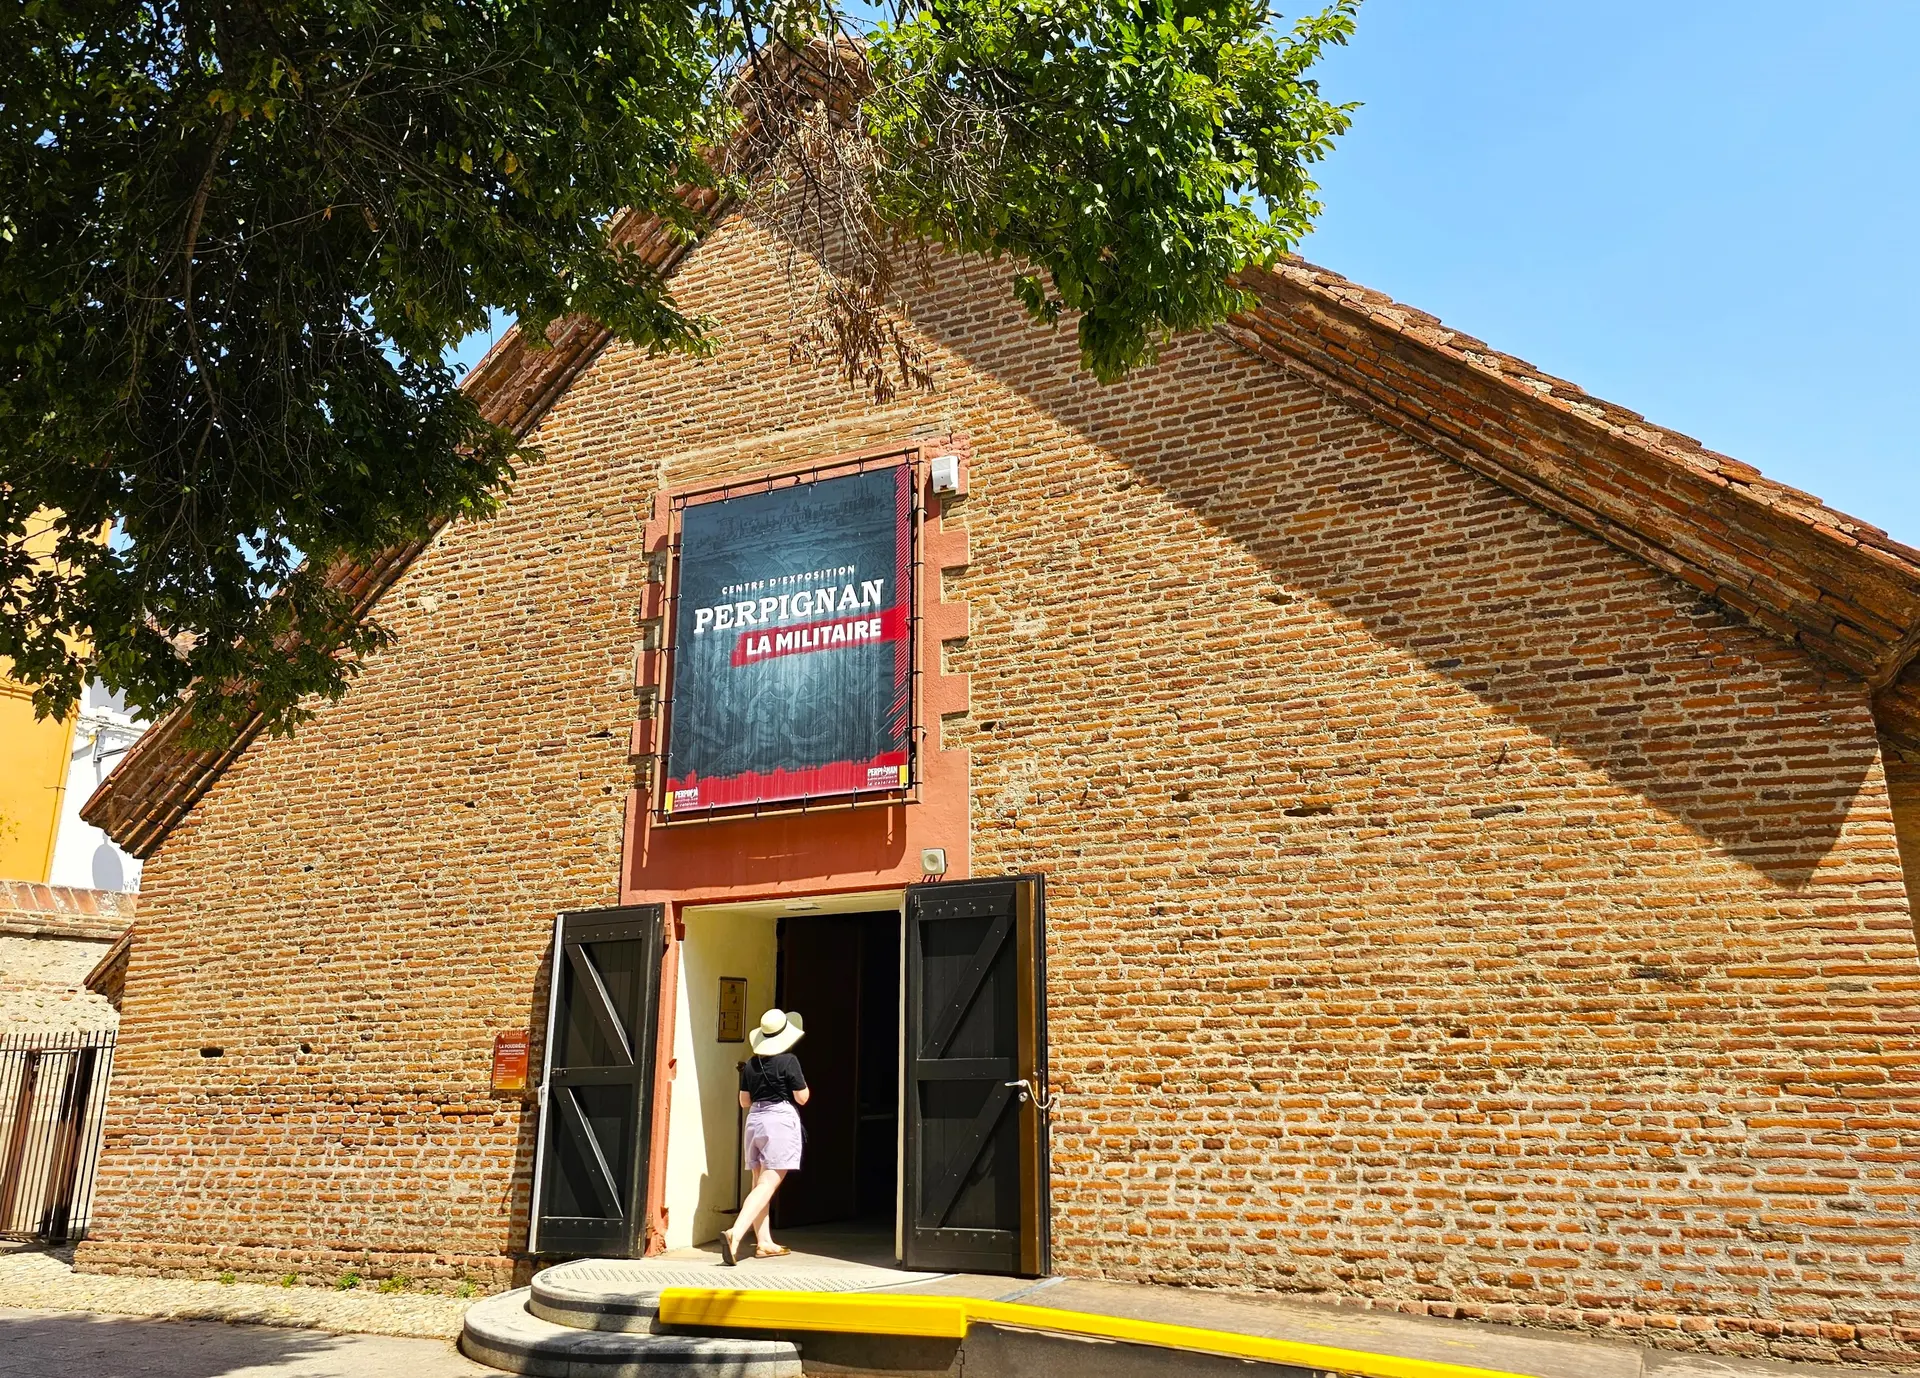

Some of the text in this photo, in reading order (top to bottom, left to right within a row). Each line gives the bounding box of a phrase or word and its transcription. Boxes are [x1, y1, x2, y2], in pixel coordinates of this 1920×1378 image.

[721, 564, 855, 595] CENTRE D'EXPOSITION
[693, 578, 884, 634] PERPIGNAN
[746, 617, 882, 656] LA MILITAIRE
